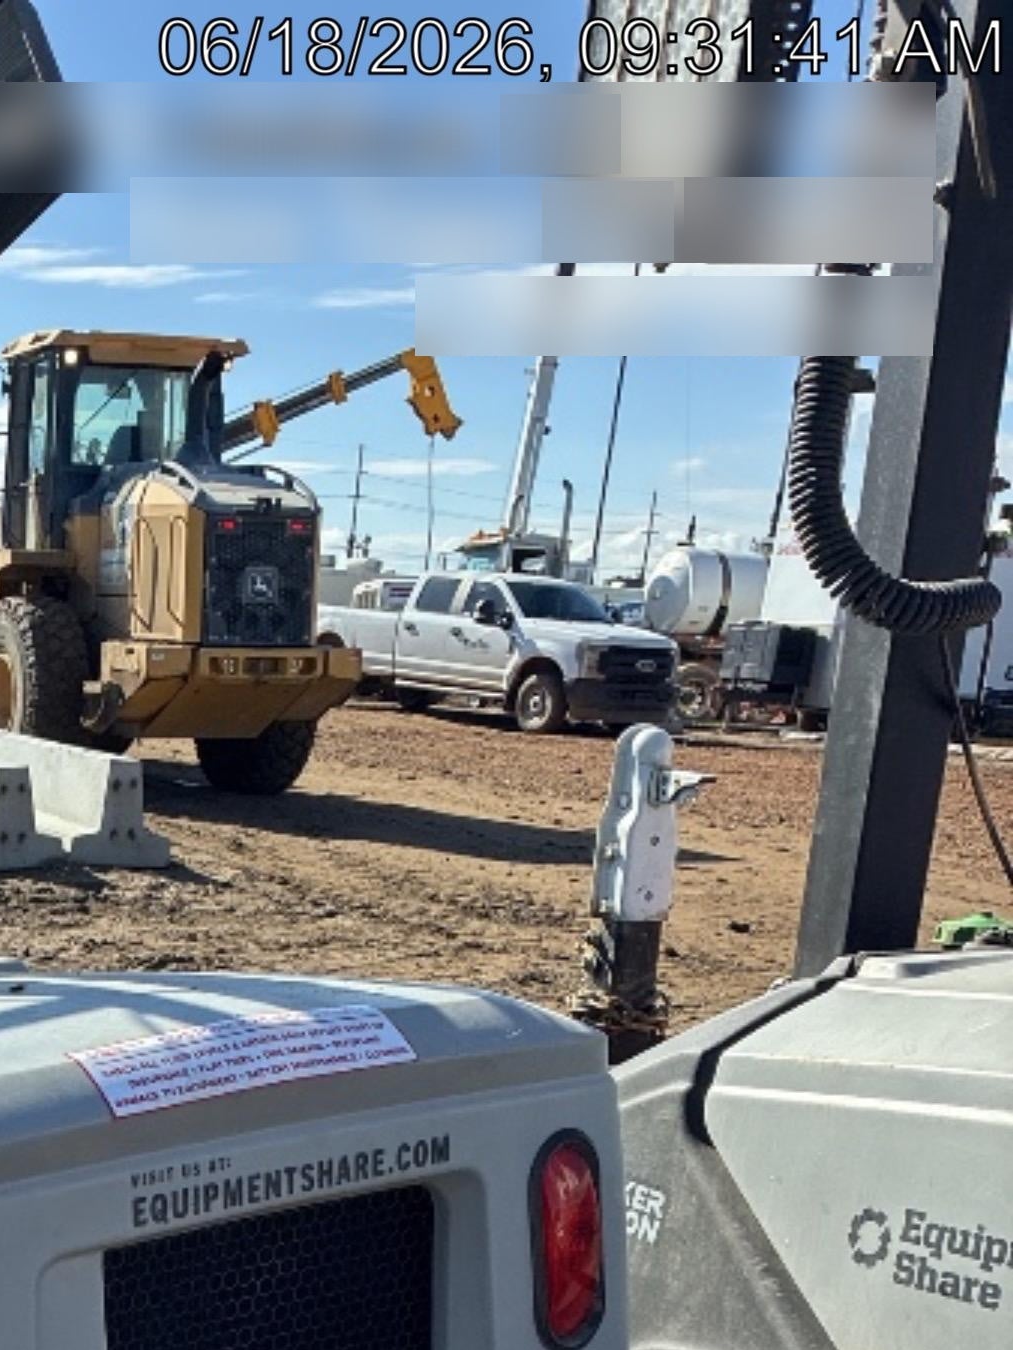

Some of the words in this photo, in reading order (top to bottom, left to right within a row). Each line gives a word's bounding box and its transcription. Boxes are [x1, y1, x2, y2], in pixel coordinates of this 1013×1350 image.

[130, 1166, 174, 1188] VISIT
[181, 1161, 201, 1178] US
[131, 1133, 452, 1228] EQUIPMENTSHARE.COM
[893, 1249, 1003, 1311] Share
